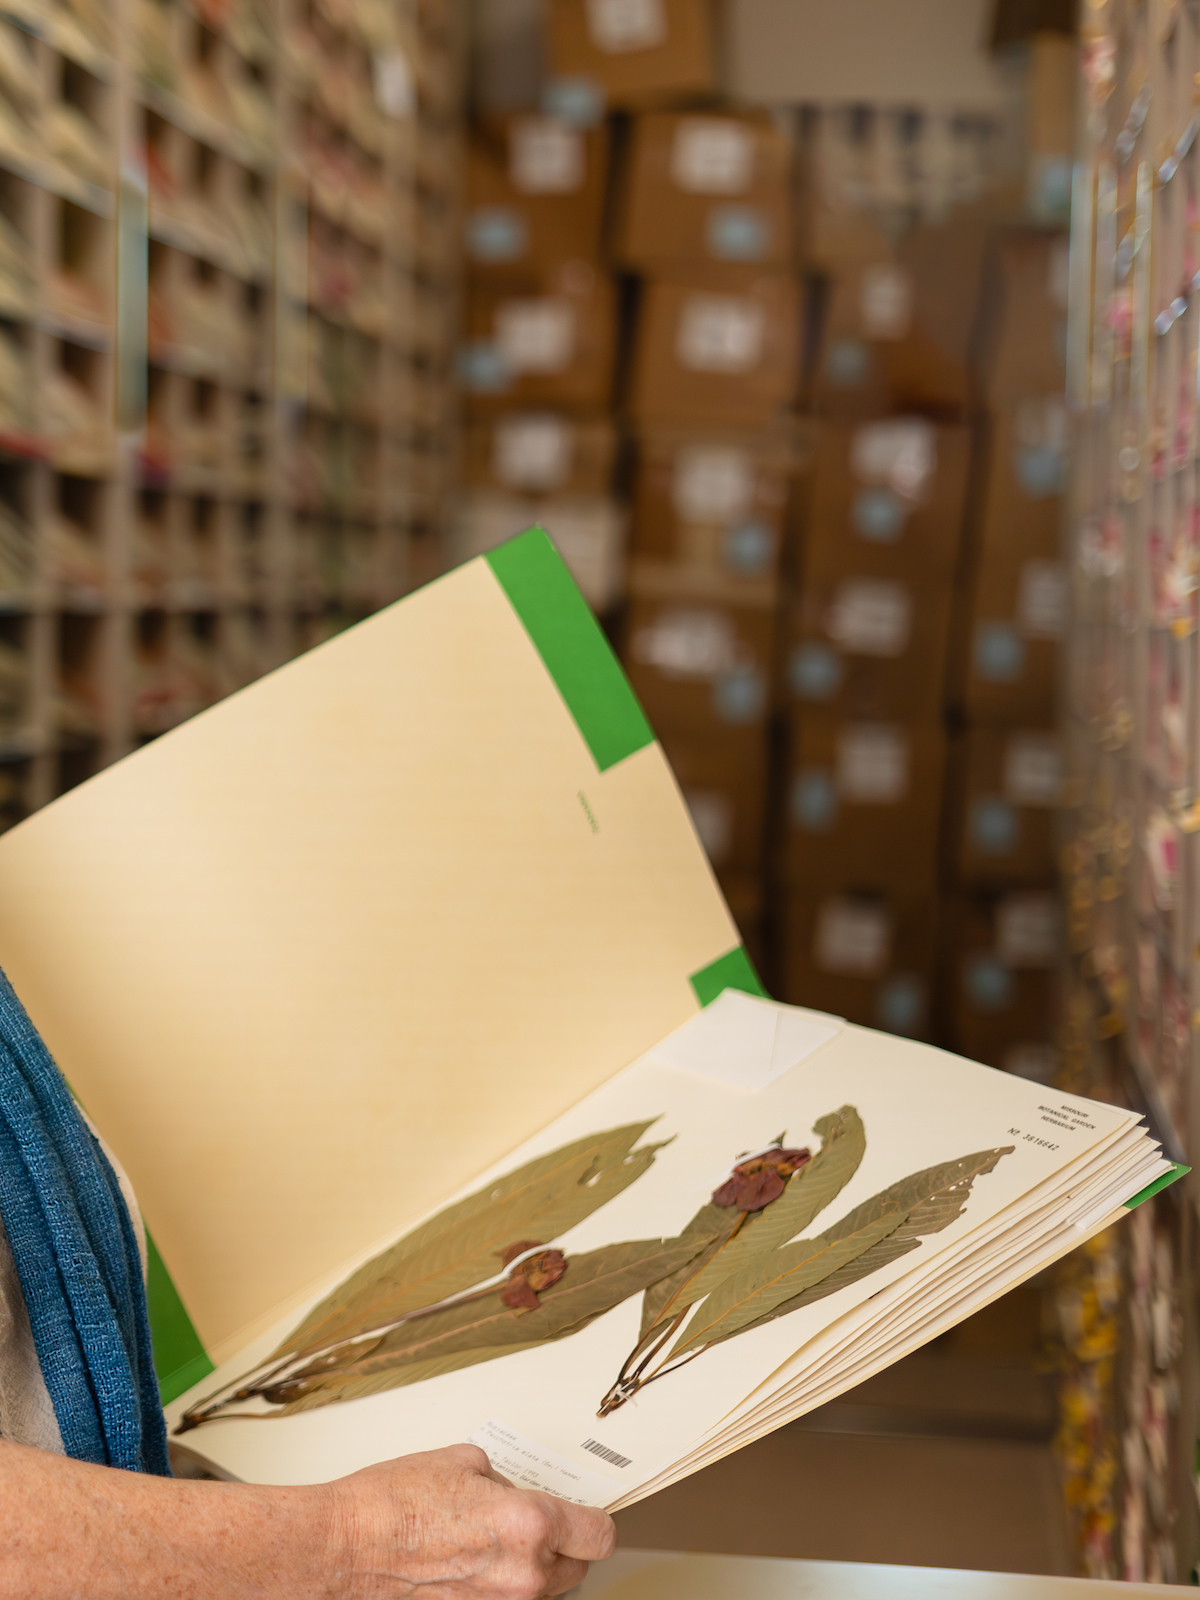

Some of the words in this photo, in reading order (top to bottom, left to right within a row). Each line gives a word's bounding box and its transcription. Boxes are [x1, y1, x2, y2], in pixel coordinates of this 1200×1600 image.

[1037, 1105, 1070, 1121] BOTANICAL
[1070, 1118, 1096, 1131] GARDEN
[1060, 1104, 1090, 1118] MISSOURI
[1040, 1115, 1077, 1131] HERBARIUM
[502, 1456, 523, 1470] Taylor
[519, 1474, 542, 1488] Garden
